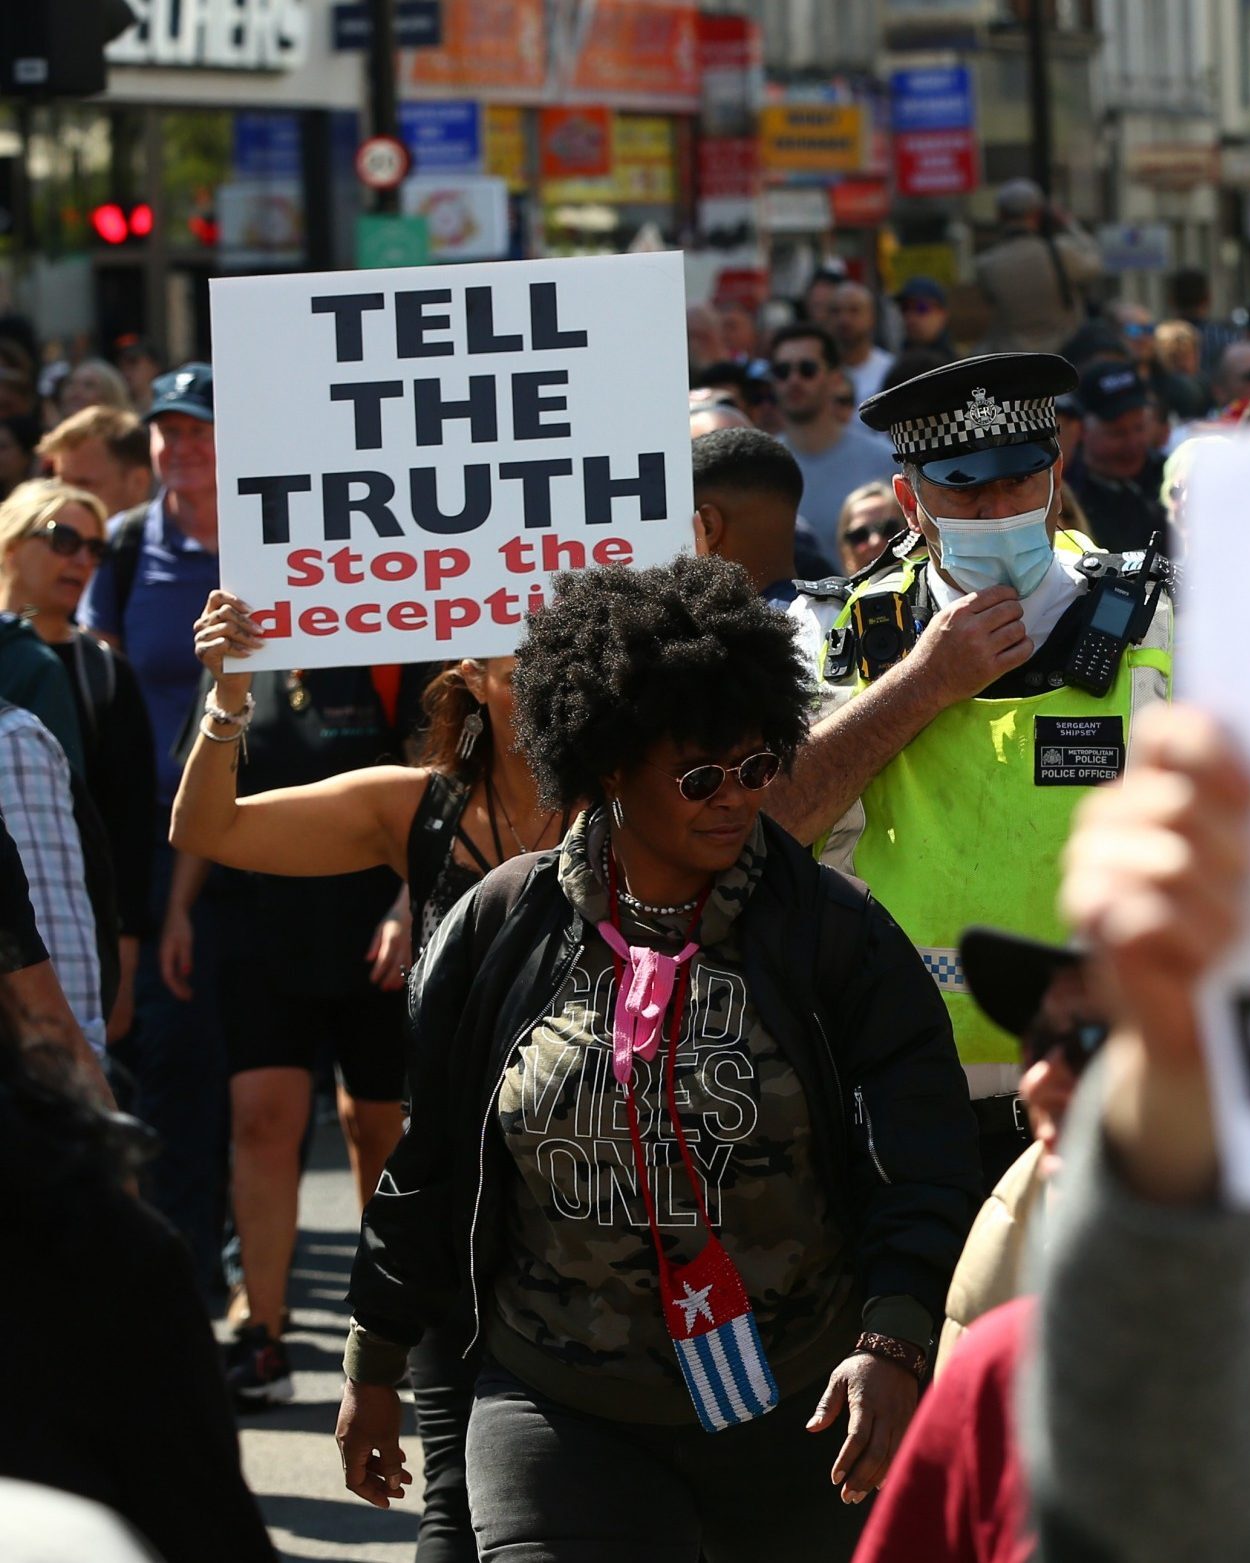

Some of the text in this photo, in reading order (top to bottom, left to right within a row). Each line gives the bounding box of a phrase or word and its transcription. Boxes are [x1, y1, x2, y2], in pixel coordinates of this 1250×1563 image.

[310, 281, 588, 363] TELL
[329, 369, 572, 451] THE
[236, 451, 668, 545] TRUTH
[286, 534, 634, 591] Stop the
[248, 583, 545, 641] decepti
[1060, 729, 1097, 737] SHIPSEY
[1075, 755, 1108, 764] POLICE
[1041, 769, 1118, 780] POLICE OFFICER
[540, 962, 747, 1050] GD
[517, 1043, 758, 1142] VIBES
[536, 1138, 735, 1227] ONLY
